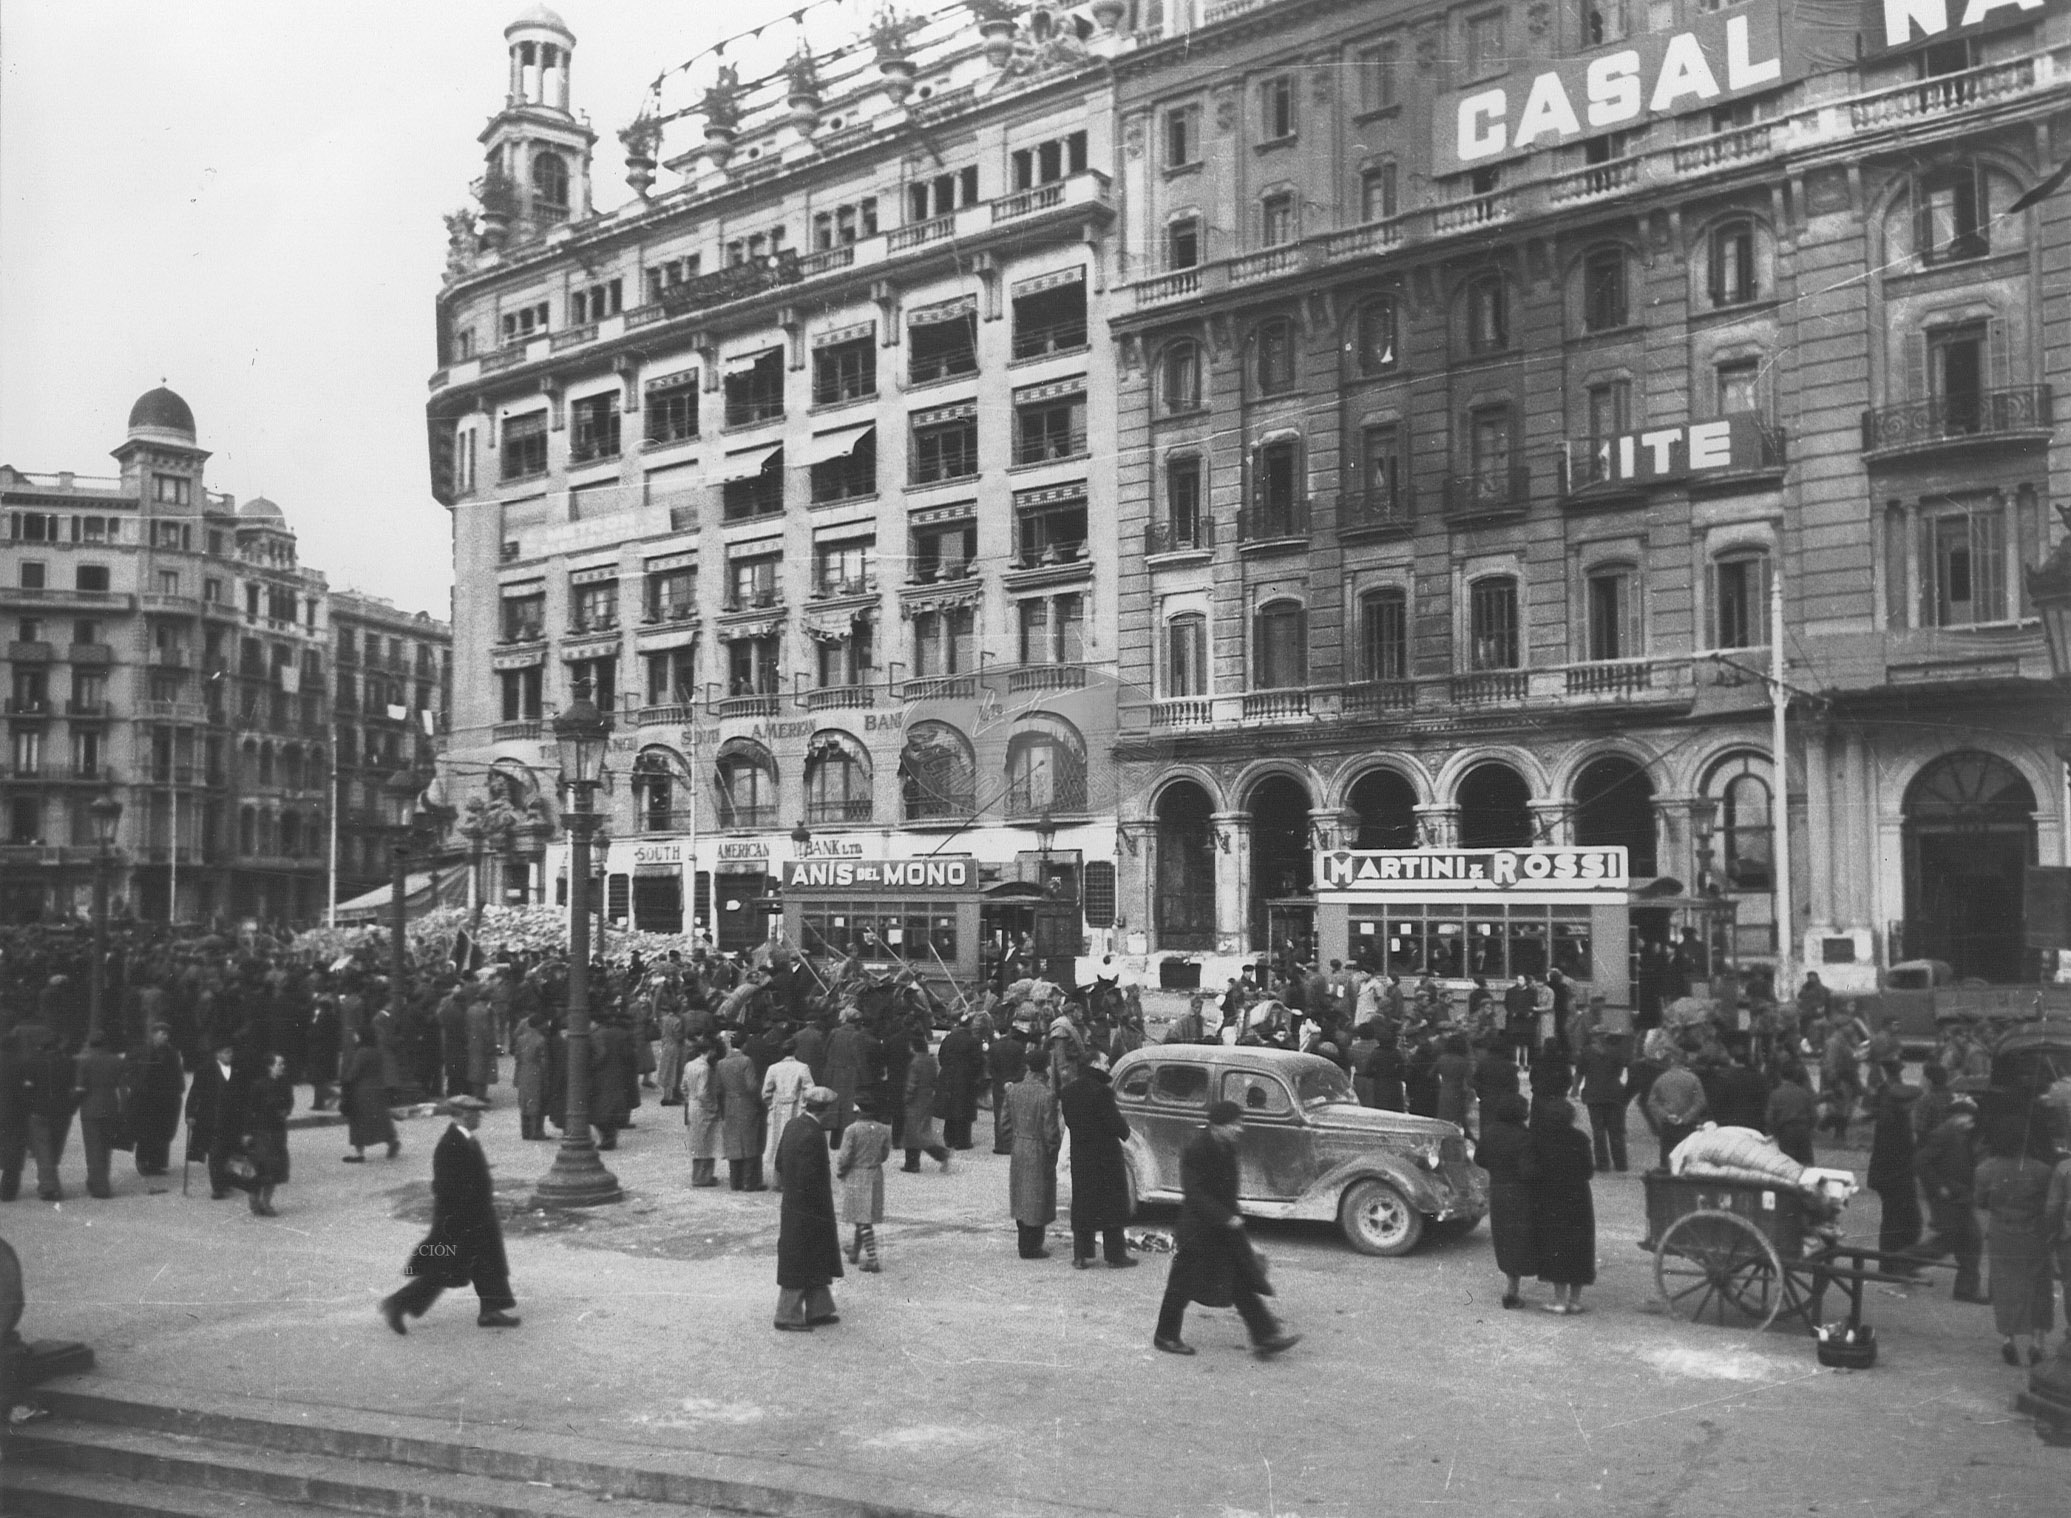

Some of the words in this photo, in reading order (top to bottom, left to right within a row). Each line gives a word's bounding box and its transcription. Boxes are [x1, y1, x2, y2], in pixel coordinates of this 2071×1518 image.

[1457, 14, 1781, 162] CASAL
[635, 846, 680, 861] SOUTH
[717, 842, 770, 859] AMERICAN
[805, 839, 840, 855] BANK
[856, 868, 881, 881] DEL
[883, 862, 966, 886] MONO
[1330, 855, 1465, 883] MARTINI
[1469, 864, 1484, 878] &
[1494, 853, 1617, 884] ROSSI
